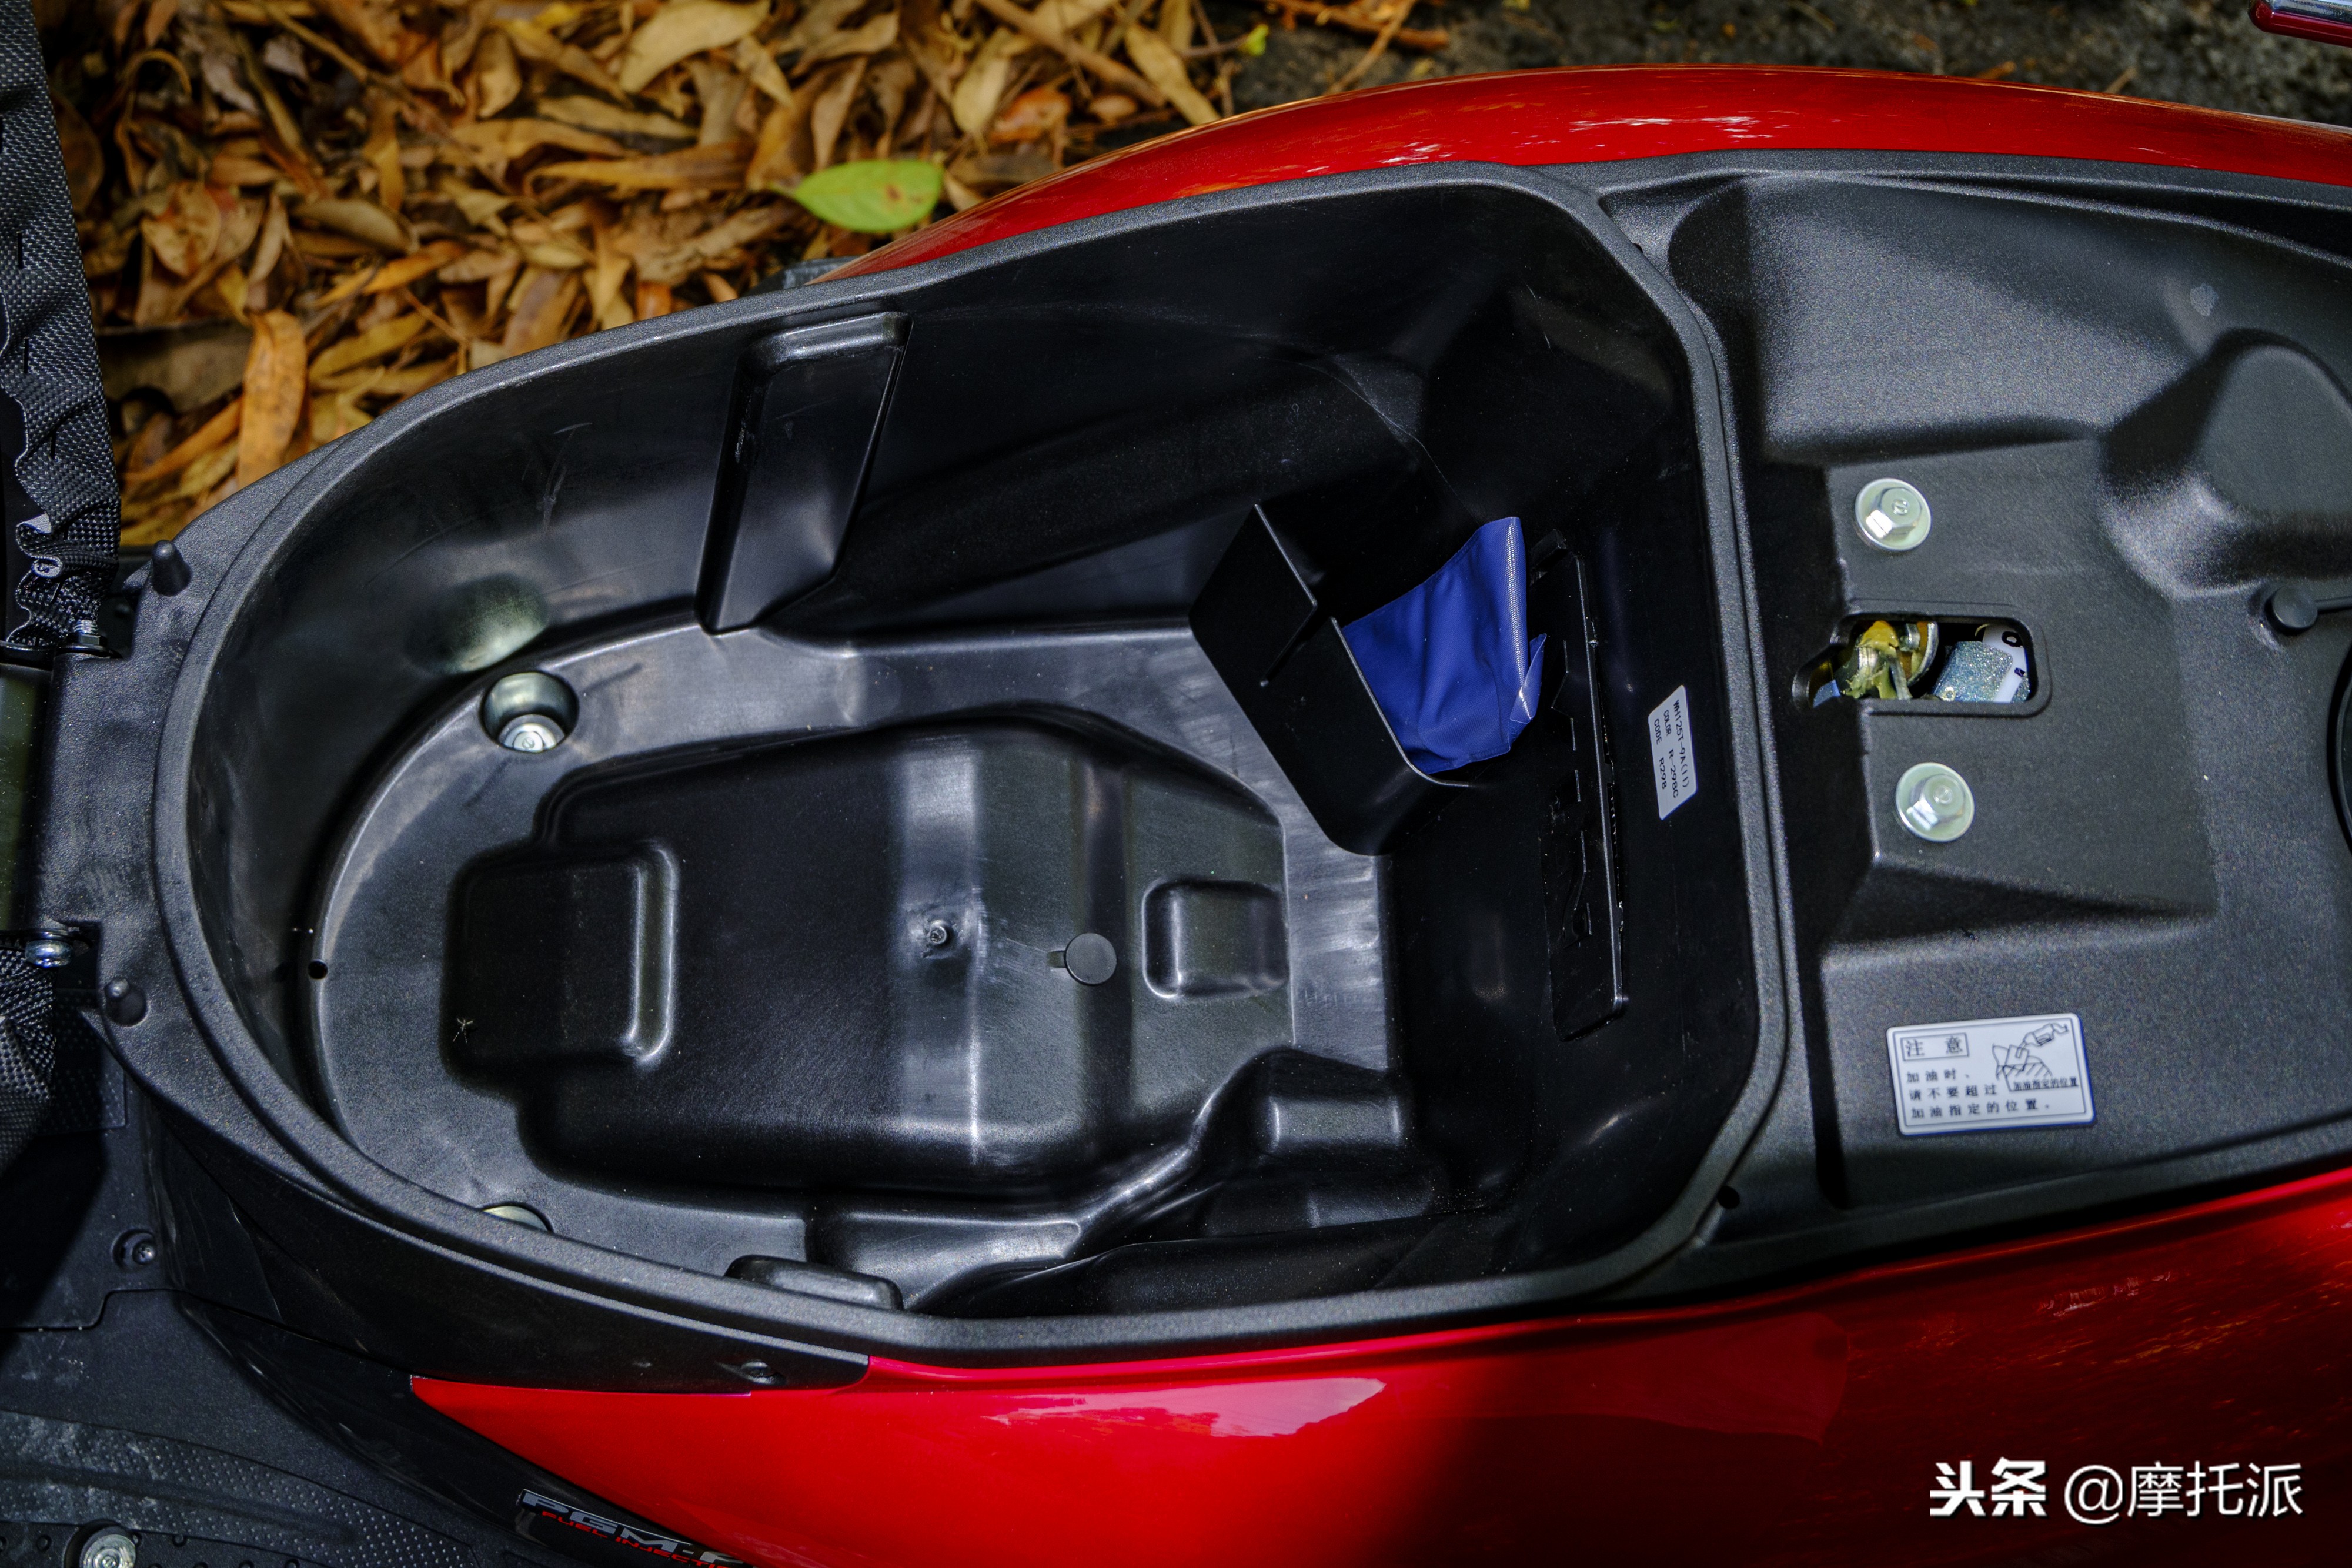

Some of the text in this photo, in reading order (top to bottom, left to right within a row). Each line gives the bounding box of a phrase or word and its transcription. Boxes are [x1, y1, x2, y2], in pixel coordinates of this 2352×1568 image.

[1659, 757, 1667, 790] R298
[1668, 749, 1678, 798] R-298C
[1905, 1035, 1964, 1057] 注意
[1909, 1083, 1997, 1101] 请不要超过
[523, 1492, 759, 1568] PGM-F
[542, 1510, 608, 1538] FUEL
